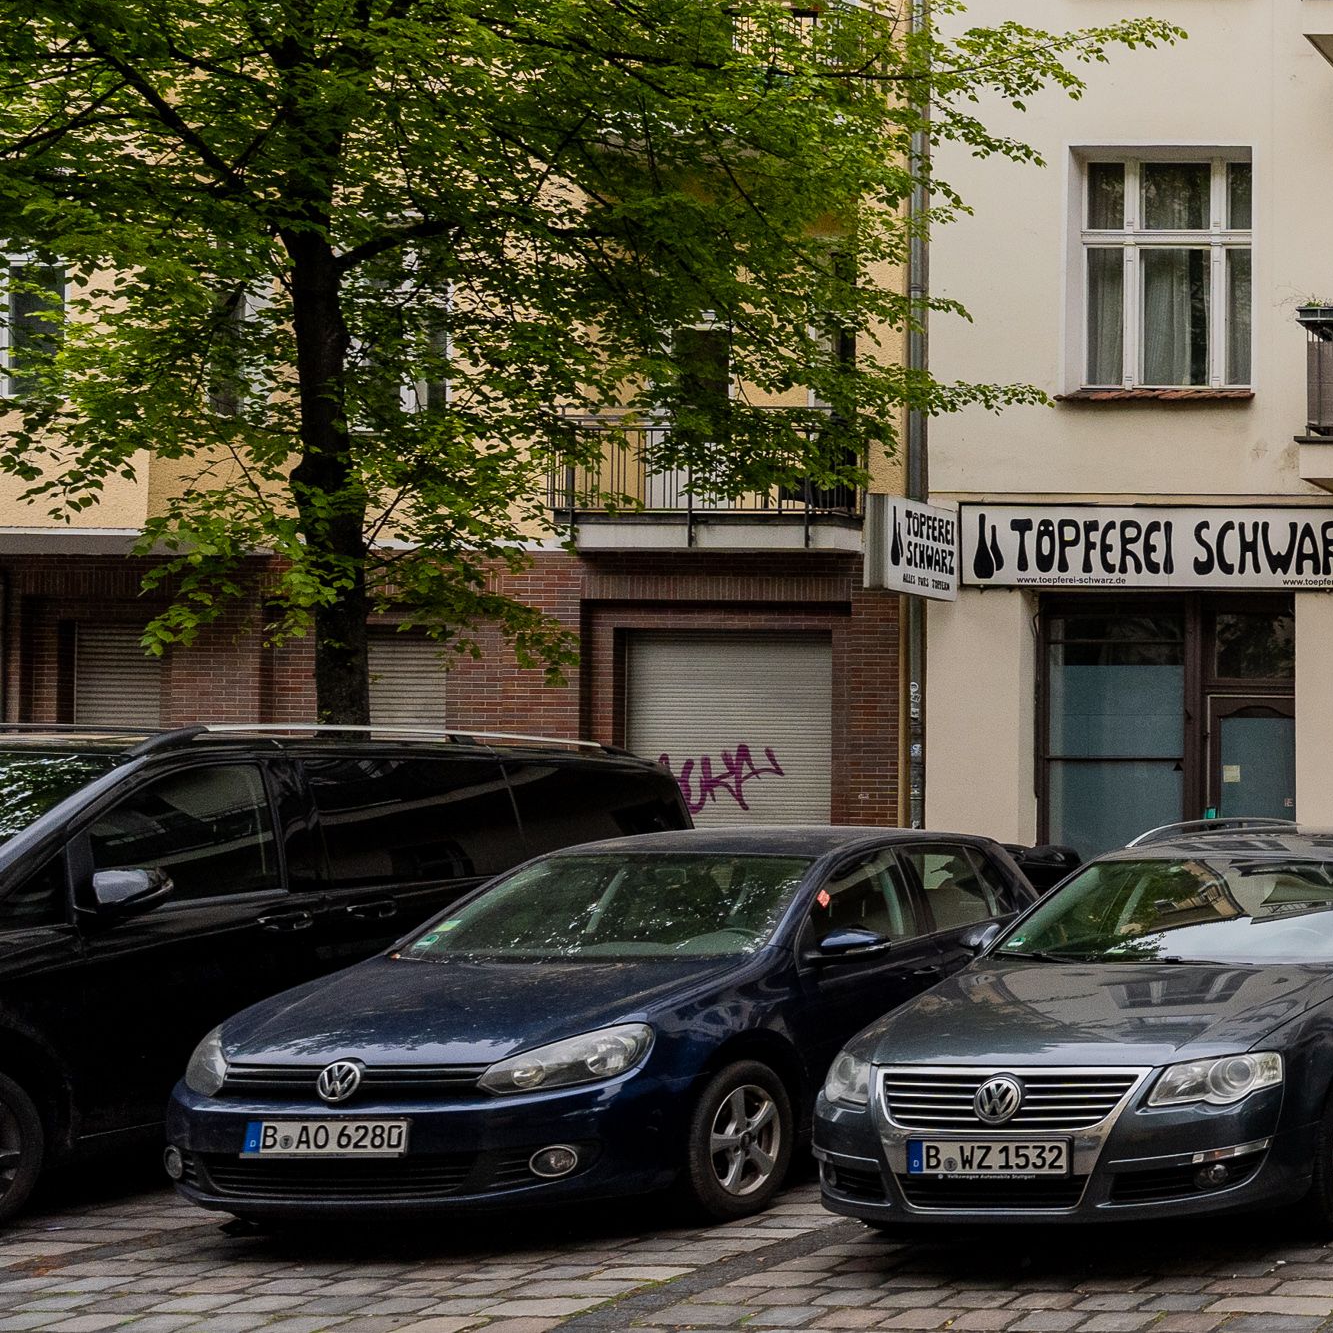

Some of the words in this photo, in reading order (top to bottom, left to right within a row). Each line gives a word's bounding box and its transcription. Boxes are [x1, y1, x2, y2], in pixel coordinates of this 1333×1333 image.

[905, 540, 955, 575] SCHWARZ
[1016, 576, 1126, 586] www.toepferei-schwarz.de
[261, 1125, 277, 1149] B
[295, 1125, 330, 1150] AO
[336, 1125, 403, 1150] 6280
[925, 1145, 941, 1170] B
[959, 1145, 993, 1170] WZ
[998, 1145, 1064, 1170] 1532
